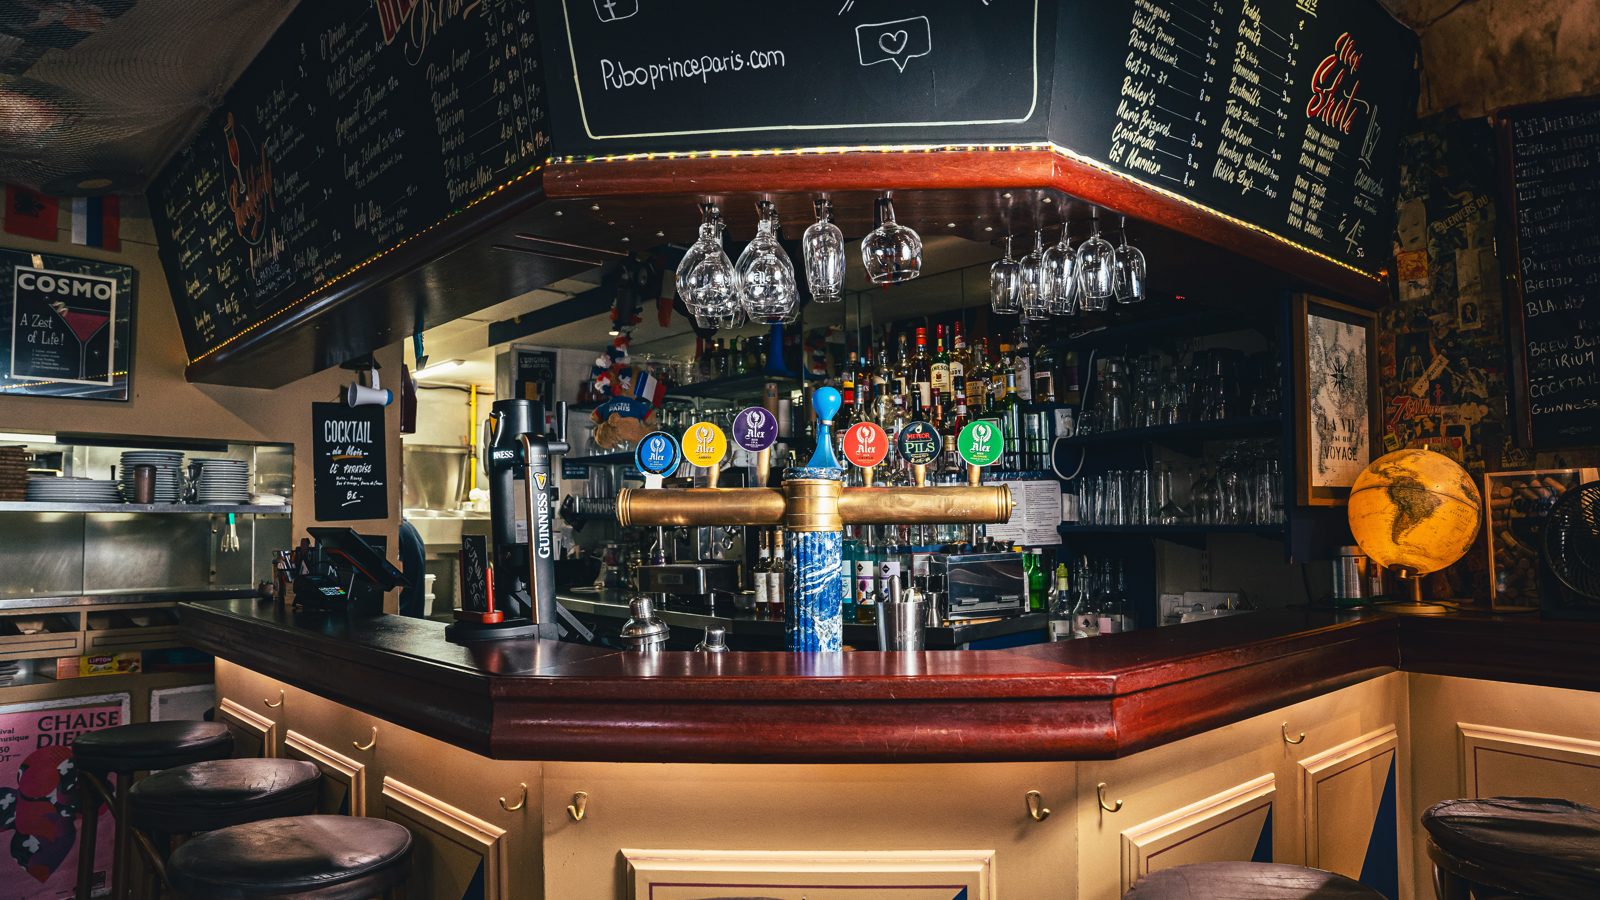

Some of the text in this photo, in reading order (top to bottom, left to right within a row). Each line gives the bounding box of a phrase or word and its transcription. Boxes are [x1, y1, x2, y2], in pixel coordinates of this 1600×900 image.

[600, 49, 786, 90] Puboprinceparis.com
[1125, 51, 1142, 75] Get
[1111, 121, 1157, 152] Cointreau
[17, 272, 112, 301] COSMO
[19, 313, 54, 329] A Zest
[27, 331, 38, 345] of
[1535, 350, 1595, 371] ELIRIUM
[324, 419, 374, 444] COCKTAIL
[744, 426, 766, 440] Alex
[855, 442, 877, 456] Alex
[904, 441, 936, 454] PILS
[969, 440, 991, 454] Alex
[329, 462, 340, 474] LE
[536, 492, 551, 559] GUINNESS
[37, 710, 120, 732] CHAISE
